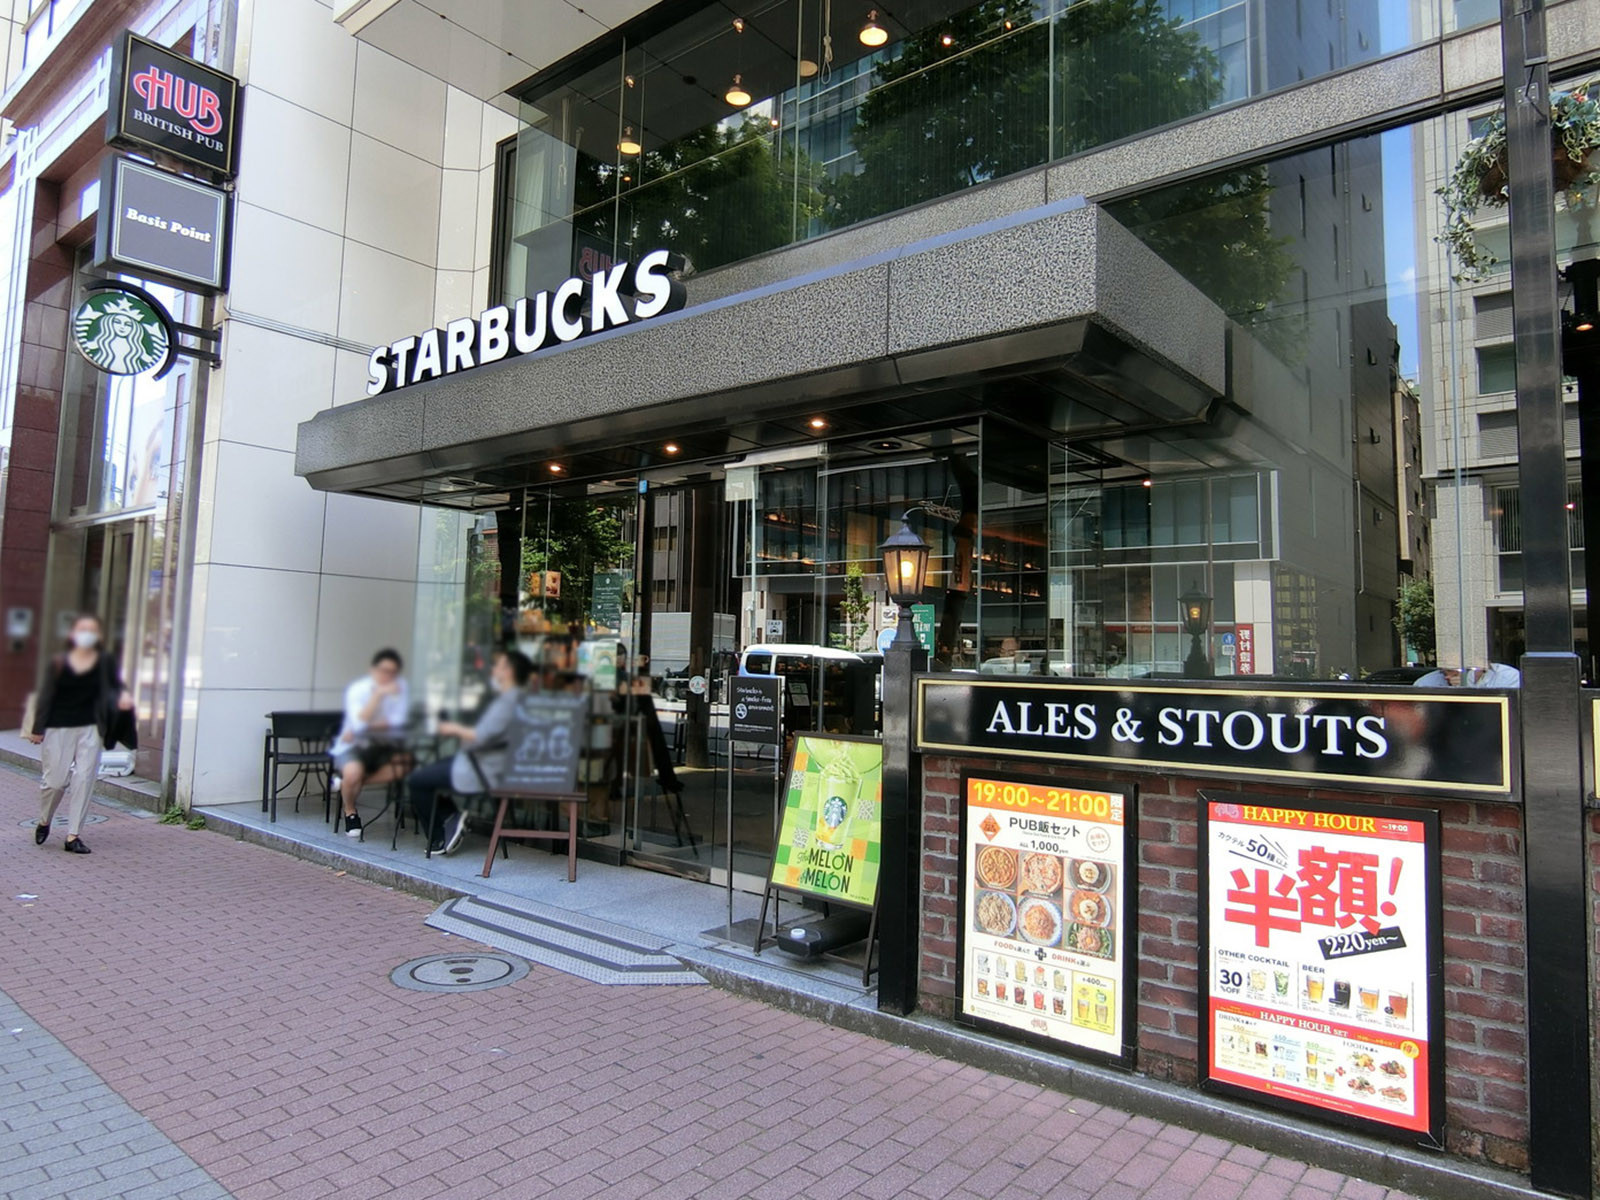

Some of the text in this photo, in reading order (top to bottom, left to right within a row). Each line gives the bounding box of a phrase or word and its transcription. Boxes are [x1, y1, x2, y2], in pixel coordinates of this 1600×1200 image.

[133, 65, 223, 135] HUB
[133, 109, 224, 152] BRITISH PUB
[126, 207, 212, 243] Basis Point
[366, 250, 670, 396] STARBUCKS
[986, 701, 1389, 759] ALES & STOUTS
[1242, 806, 1312, 826] HAPPY
[1314, 812, 1377, 833] HOUR
[1218, 949, 1246, 960] OTHER
[1248, 955, 1290, 968] COCKTAIL
[1302, 964, 1326, 975] BEER
[1219, 969, 1243, 988] 30
[1259, 1010, 1297, 1027] HAPPY
[1298, 1019, 1332, 1034] HOUR
[1333, 1028, 1349, 1038] SET
